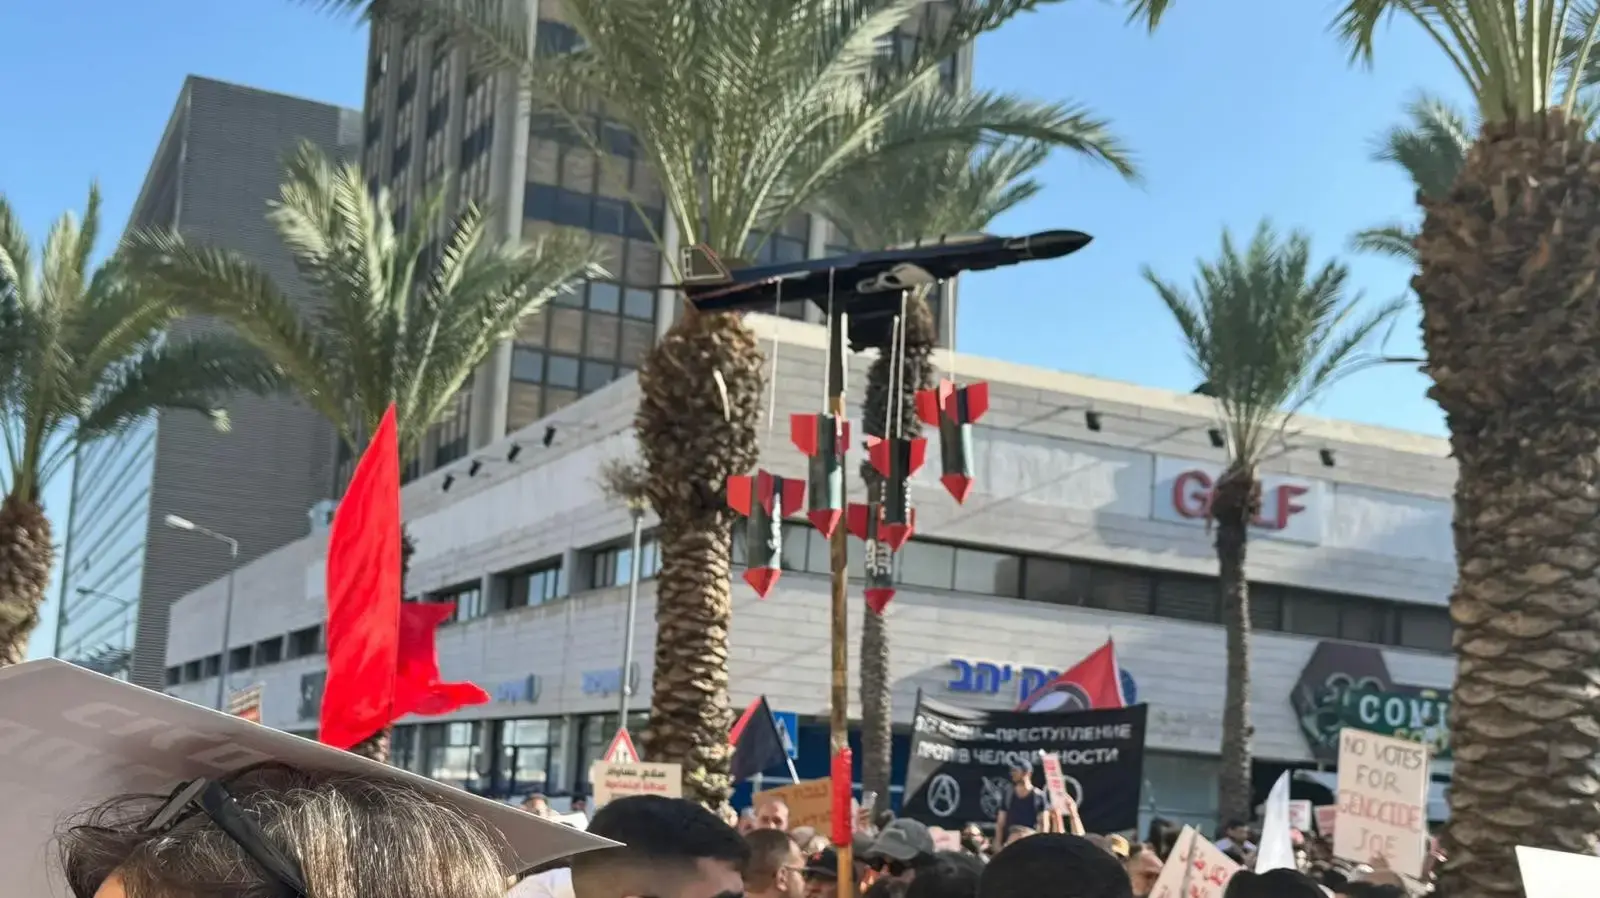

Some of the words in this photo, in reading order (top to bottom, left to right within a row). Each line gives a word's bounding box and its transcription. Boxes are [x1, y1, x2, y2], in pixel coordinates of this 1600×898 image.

[1172, 470, 1310, 530] GLF
[947, 658, 1012, 695] יהב
[972, 747, 1119, 768] ЧЕЛОВЕНОСТИ
[1344, 736, 1366, 757] NO
[1373, 742, 1422, 771] VOTES
[1356, 764, 1402, 795] FOR
[1339, 788, 1424, 834] GENOCIDE
[1353, 827, 1400, 859] JOE
